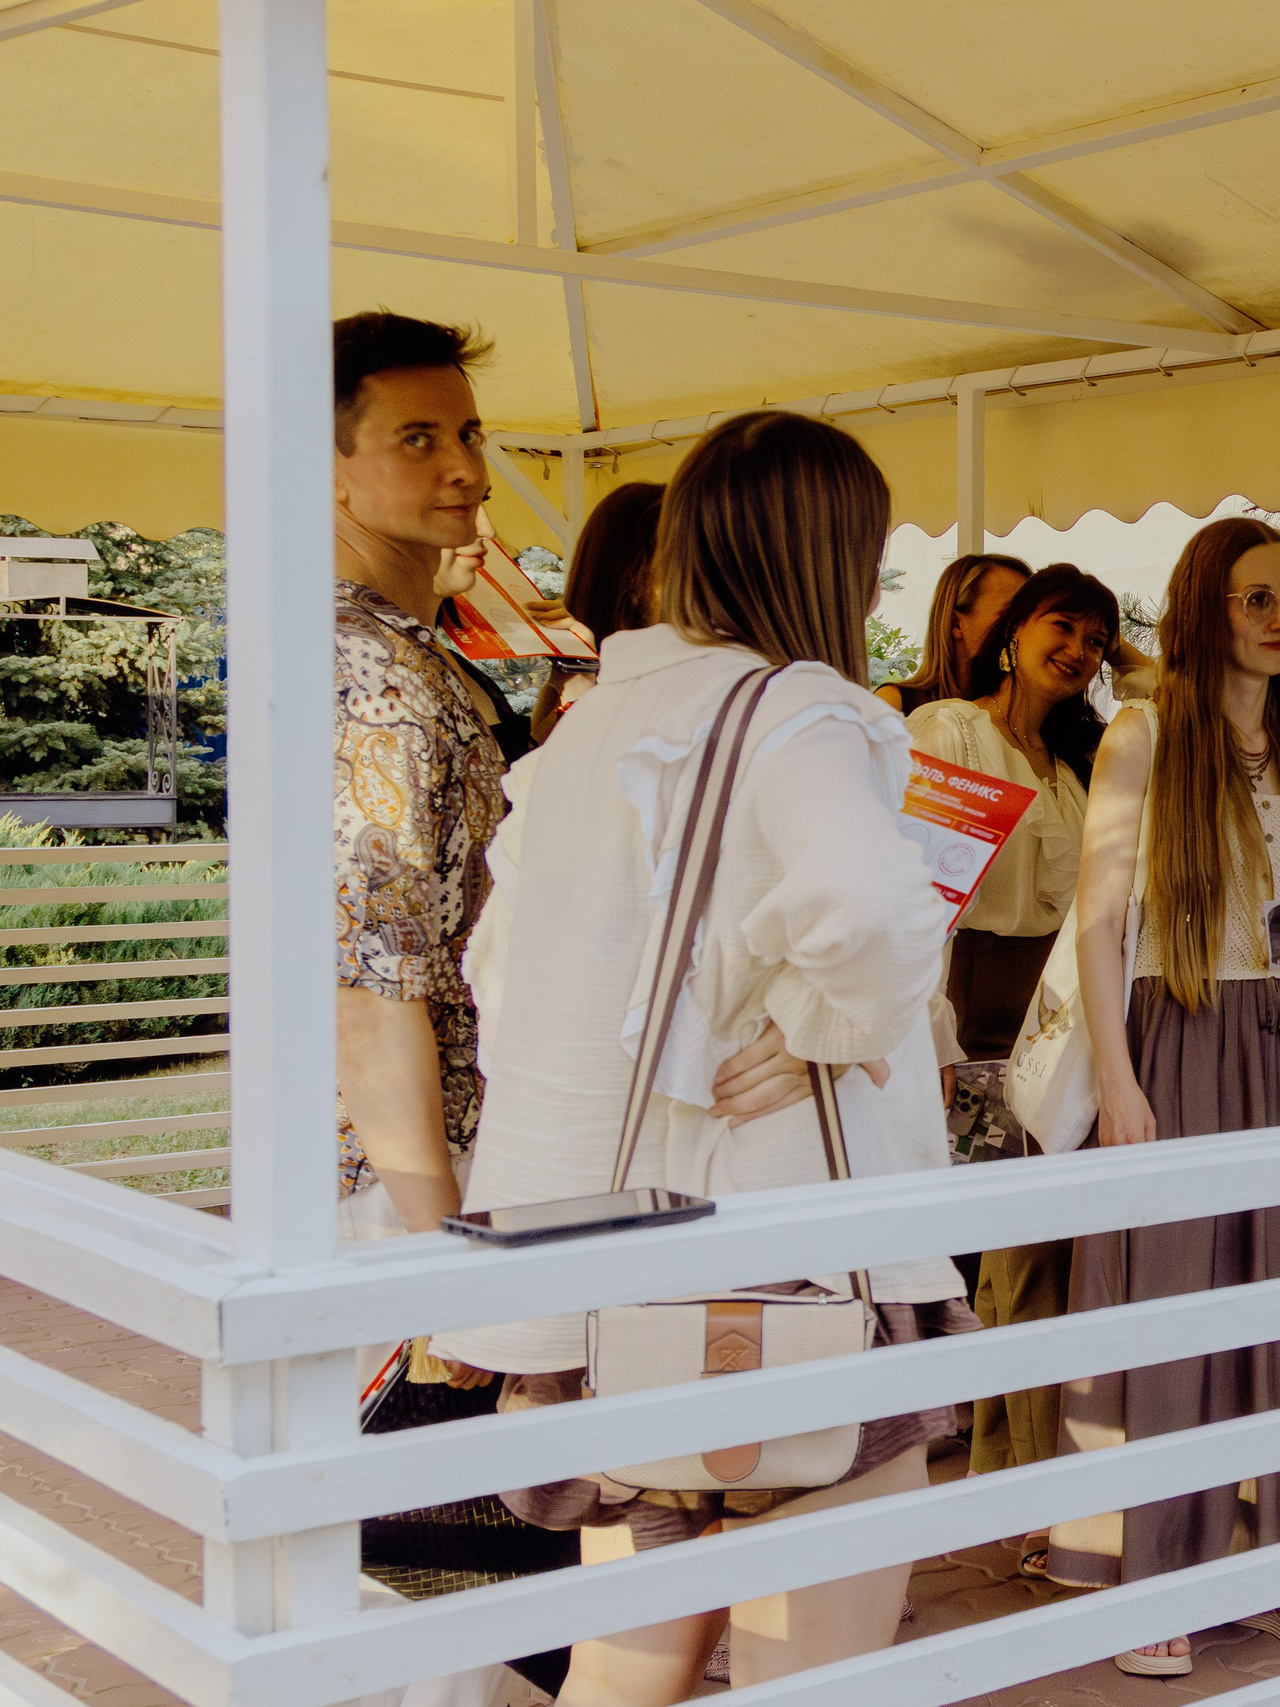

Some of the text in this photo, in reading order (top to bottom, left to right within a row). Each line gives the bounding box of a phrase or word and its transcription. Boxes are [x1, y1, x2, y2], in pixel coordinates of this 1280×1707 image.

[912, 762, 946, 783] ВАЛЬ
[947, 776, 1004, 803] ФЕНИКС
[1015, 1050, 1047, 1078] USSI
